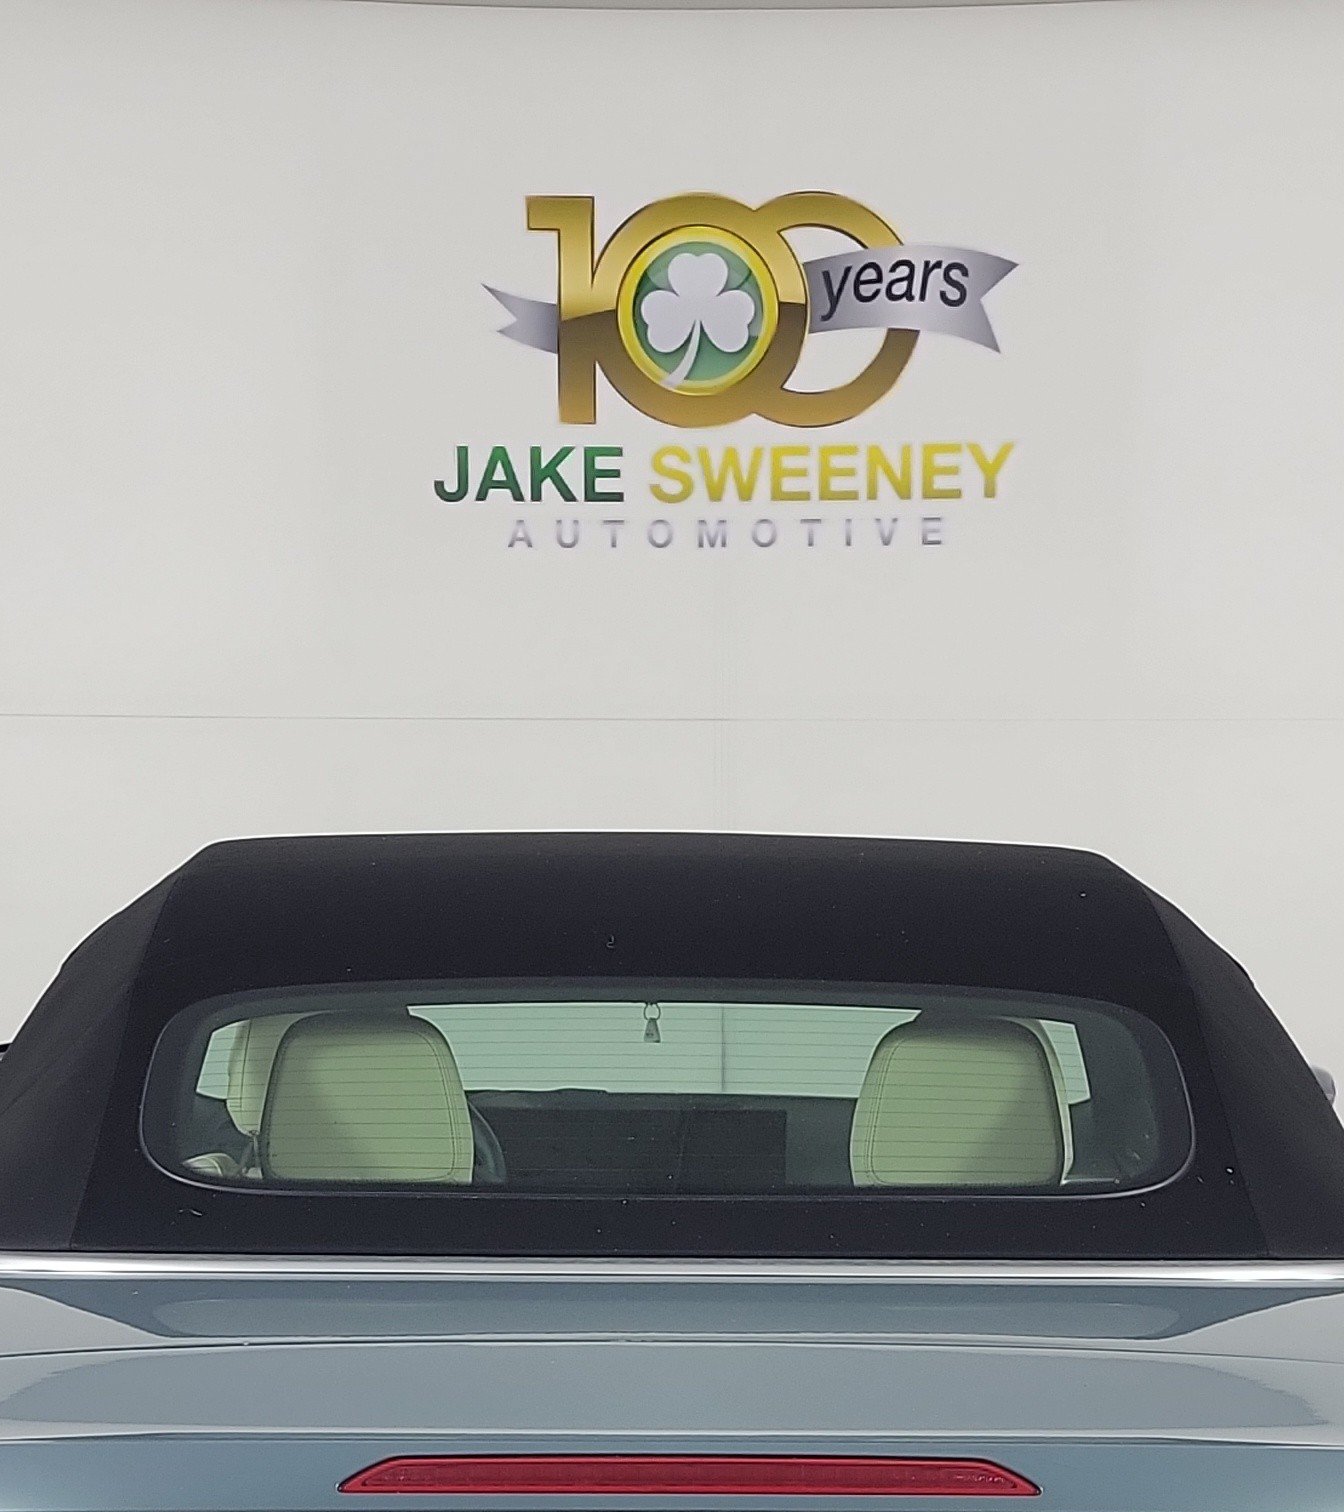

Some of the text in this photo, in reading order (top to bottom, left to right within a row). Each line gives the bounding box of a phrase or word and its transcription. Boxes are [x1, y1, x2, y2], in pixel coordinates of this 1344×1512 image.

[525, 189, 970, 429] 100 years
[433, 441, 1016, 505] JAKE SWEENEY
[507, 515, 945, 549] AUTOMOTIVE
